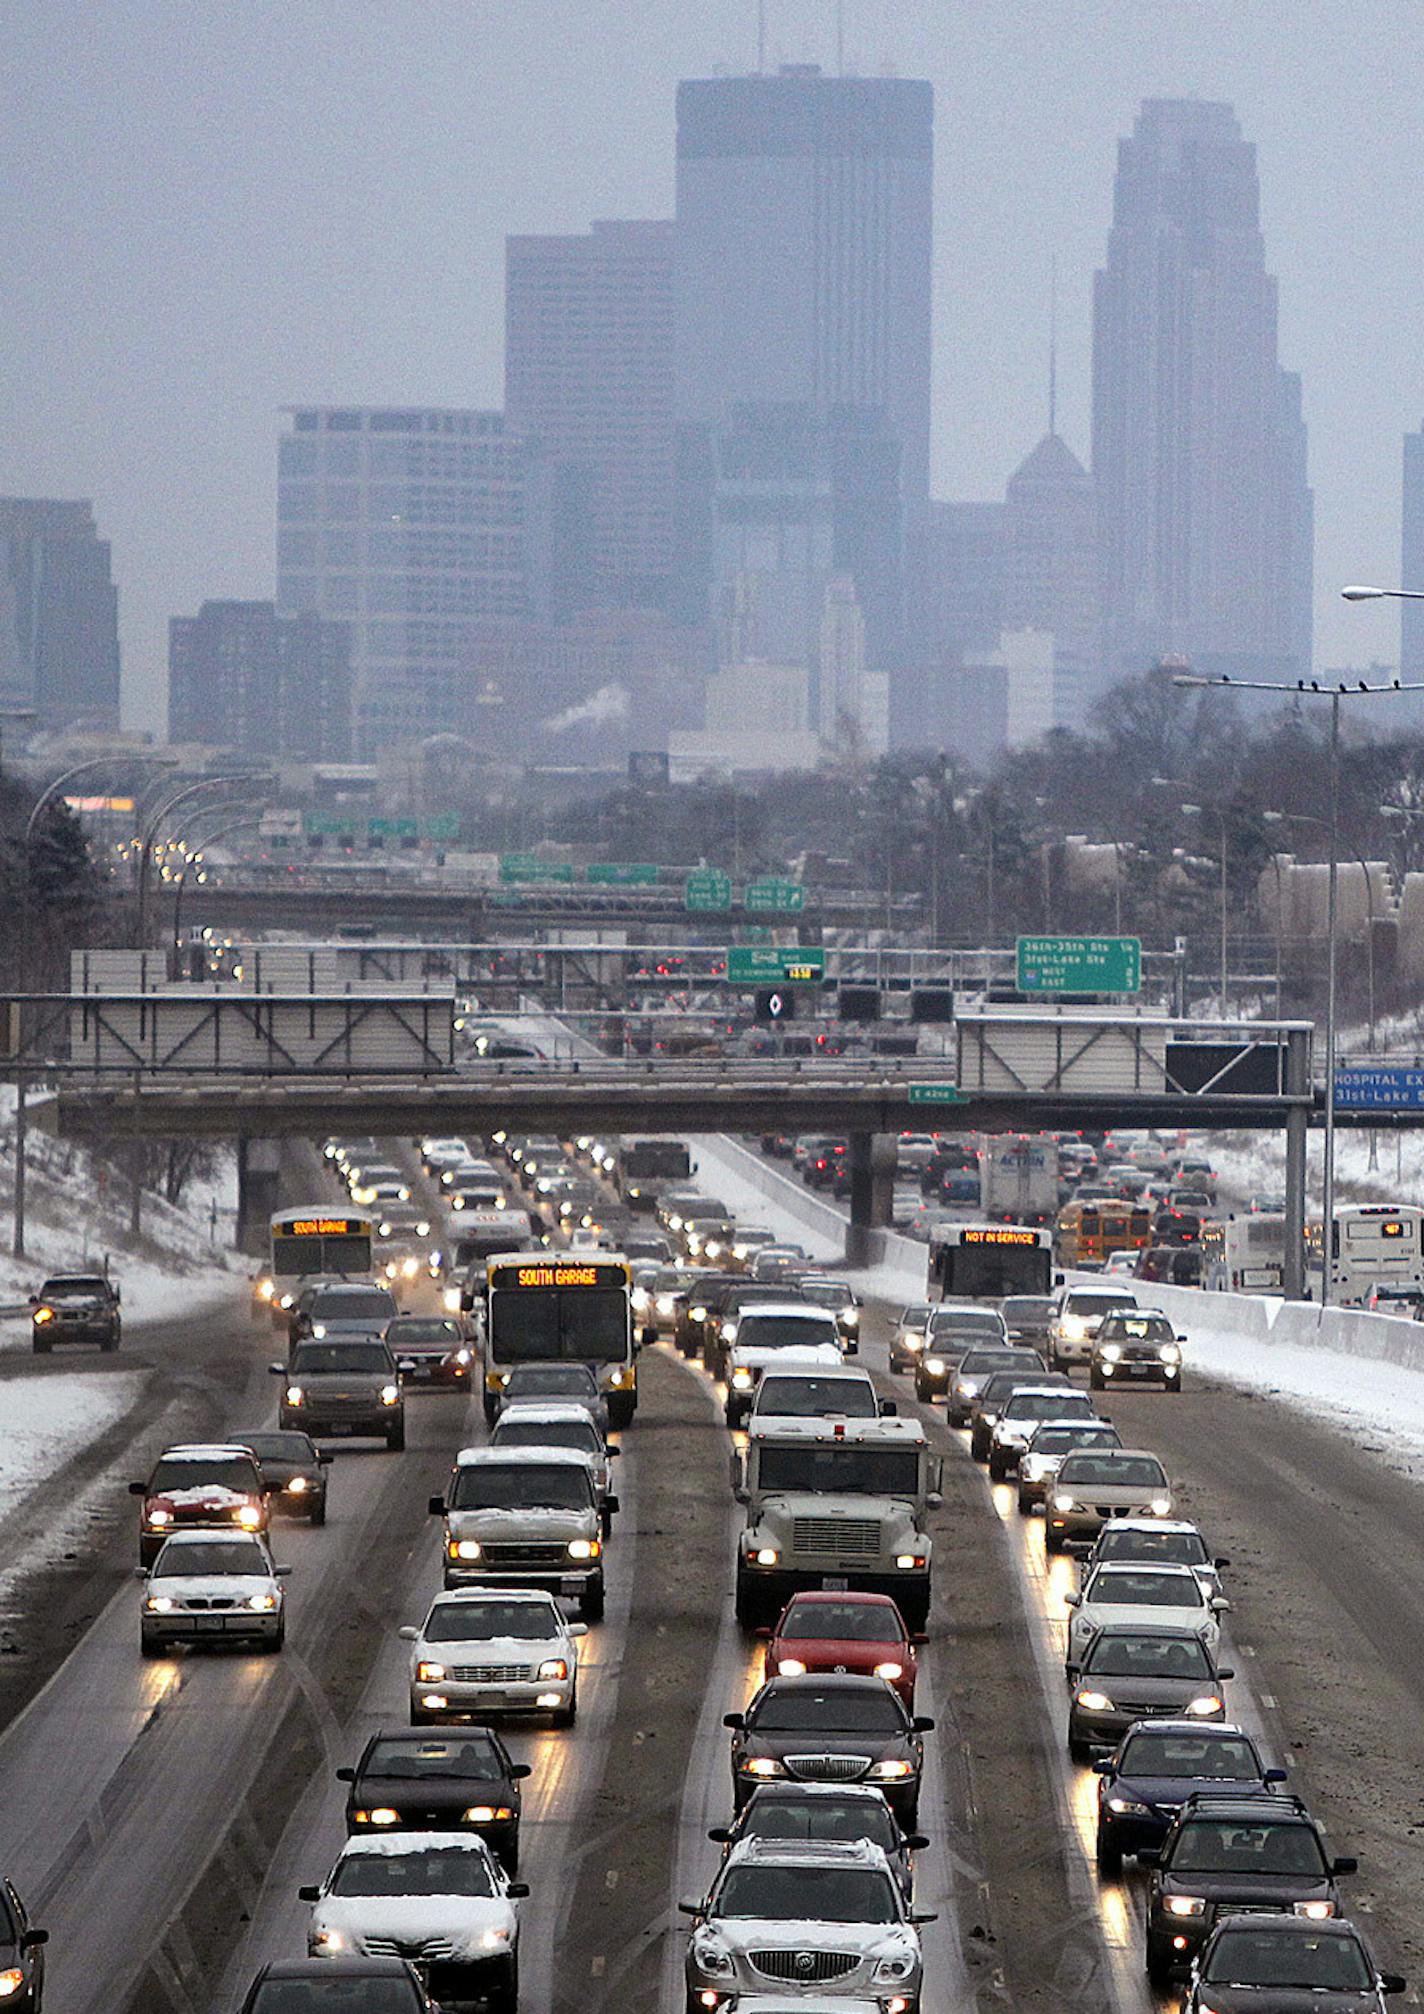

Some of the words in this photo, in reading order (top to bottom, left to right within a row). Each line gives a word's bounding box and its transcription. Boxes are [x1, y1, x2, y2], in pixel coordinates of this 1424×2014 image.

[1024, 954, 1081, 964] 31st-Lake
[1086, 954, 1105, 964] Sts
[1334, 1074, 1399, 1086] HOSPITAL
[1336, 1089, 1409, 1102] 31st-Lake
[965, 1231, 985, 1243] NOT
[985, 1231, 996, 1243] IN
[996, 1232, 1034, 1245] SERVICE
[518, 1269, 554, 1286] SOUTH
[555, 1267, 597, 1285] GARAGE
